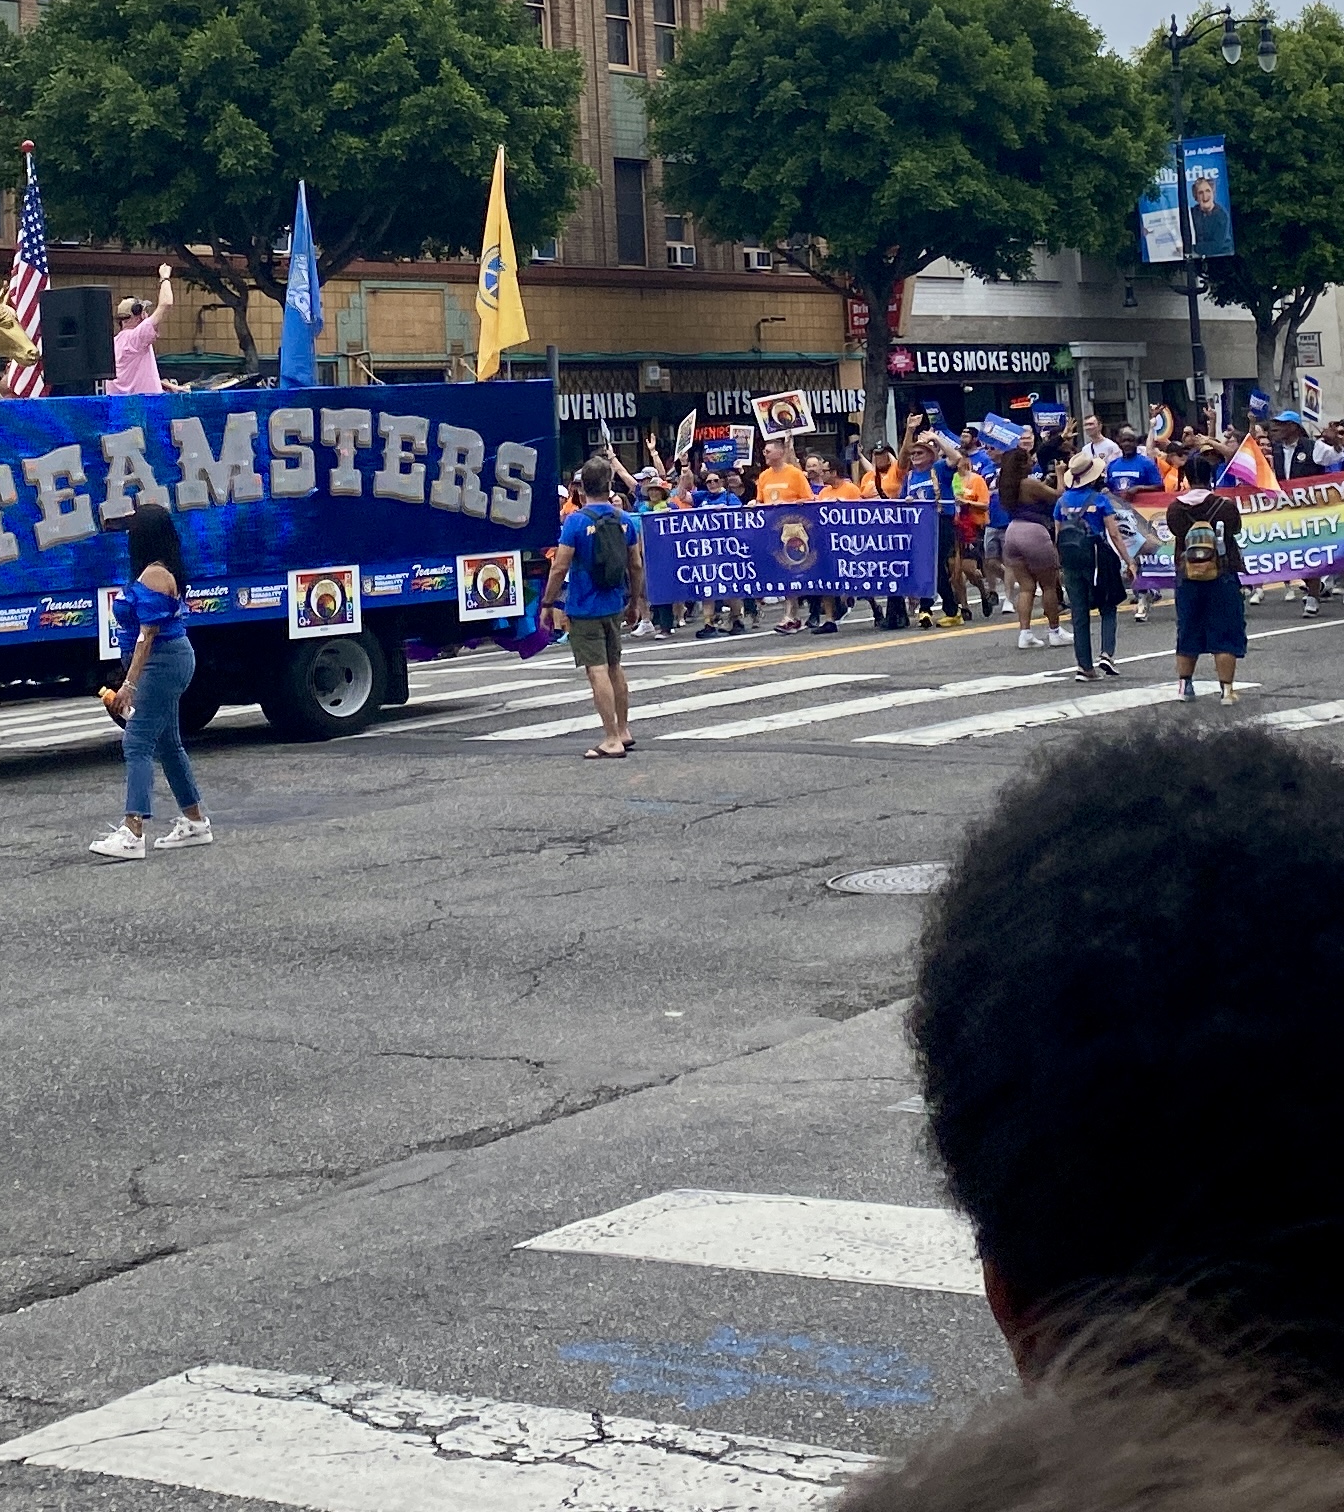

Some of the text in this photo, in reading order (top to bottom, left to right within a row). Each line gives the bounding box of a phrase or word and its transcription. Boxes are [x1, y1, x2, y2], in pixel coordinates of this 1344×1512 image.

[916, 350, 1051, 373] LEO SMOKE SHOP
[707, 390, 752, 416] GIFTS
[805, 389, 866, 414] VENIRS
[655, 510, 766, 536] TEAMSTERS
[819, 506, 924, 526] SOLIDARITY
[1233, 514, 1341, 548] QUALITY
[675, 536, 752, 559] LGBTQ+
[830, 532, 913, 556] EQUALITY
[412, 564, 454, 578] Teamster
[837, 559, 911, 579] RESPECT
[1243, 544, 1339, 575] ESPECT
[676, 561, 757, 583] CAUCUS
[40, 597, 93, 612] Teamster
